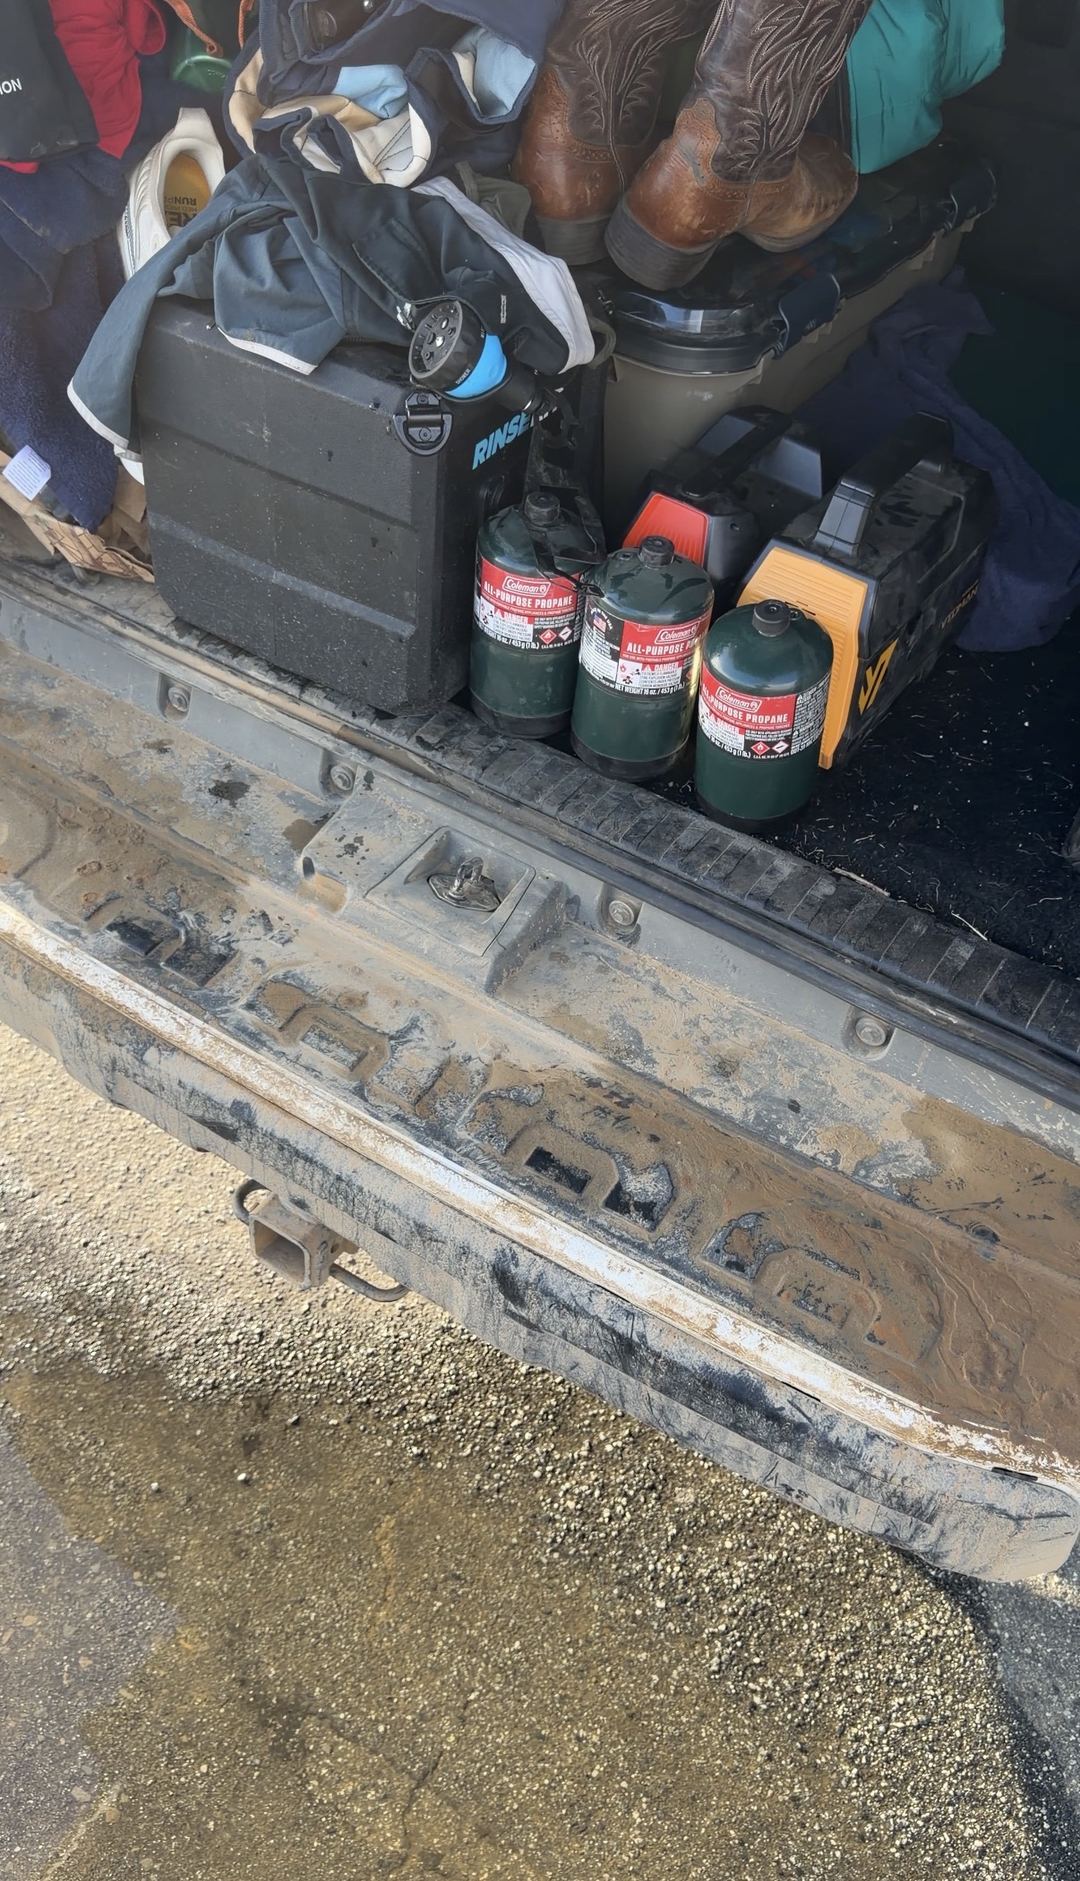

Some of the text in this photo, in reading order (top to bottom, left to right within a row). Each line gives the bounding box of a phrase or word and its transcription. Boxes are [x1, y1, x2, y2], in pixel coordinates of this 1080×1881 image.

[472, 411, 549, 470] RINSE
[506, 579, 539, 593] Coleman
[484, 581, 573, 608] ALL-PURPOSE PROPANE
[660, 629, 691, 641] Coleman
[627, 642, 685, 656] ALL-PURPOSE
[654, 661, 679, 672] DANGER
[625, 687, 643, 695] WEIGHT
[703, 684, 788, 724] ALL-PURPOSE PROPANE
[719, 690, 750, 708] Coleman
